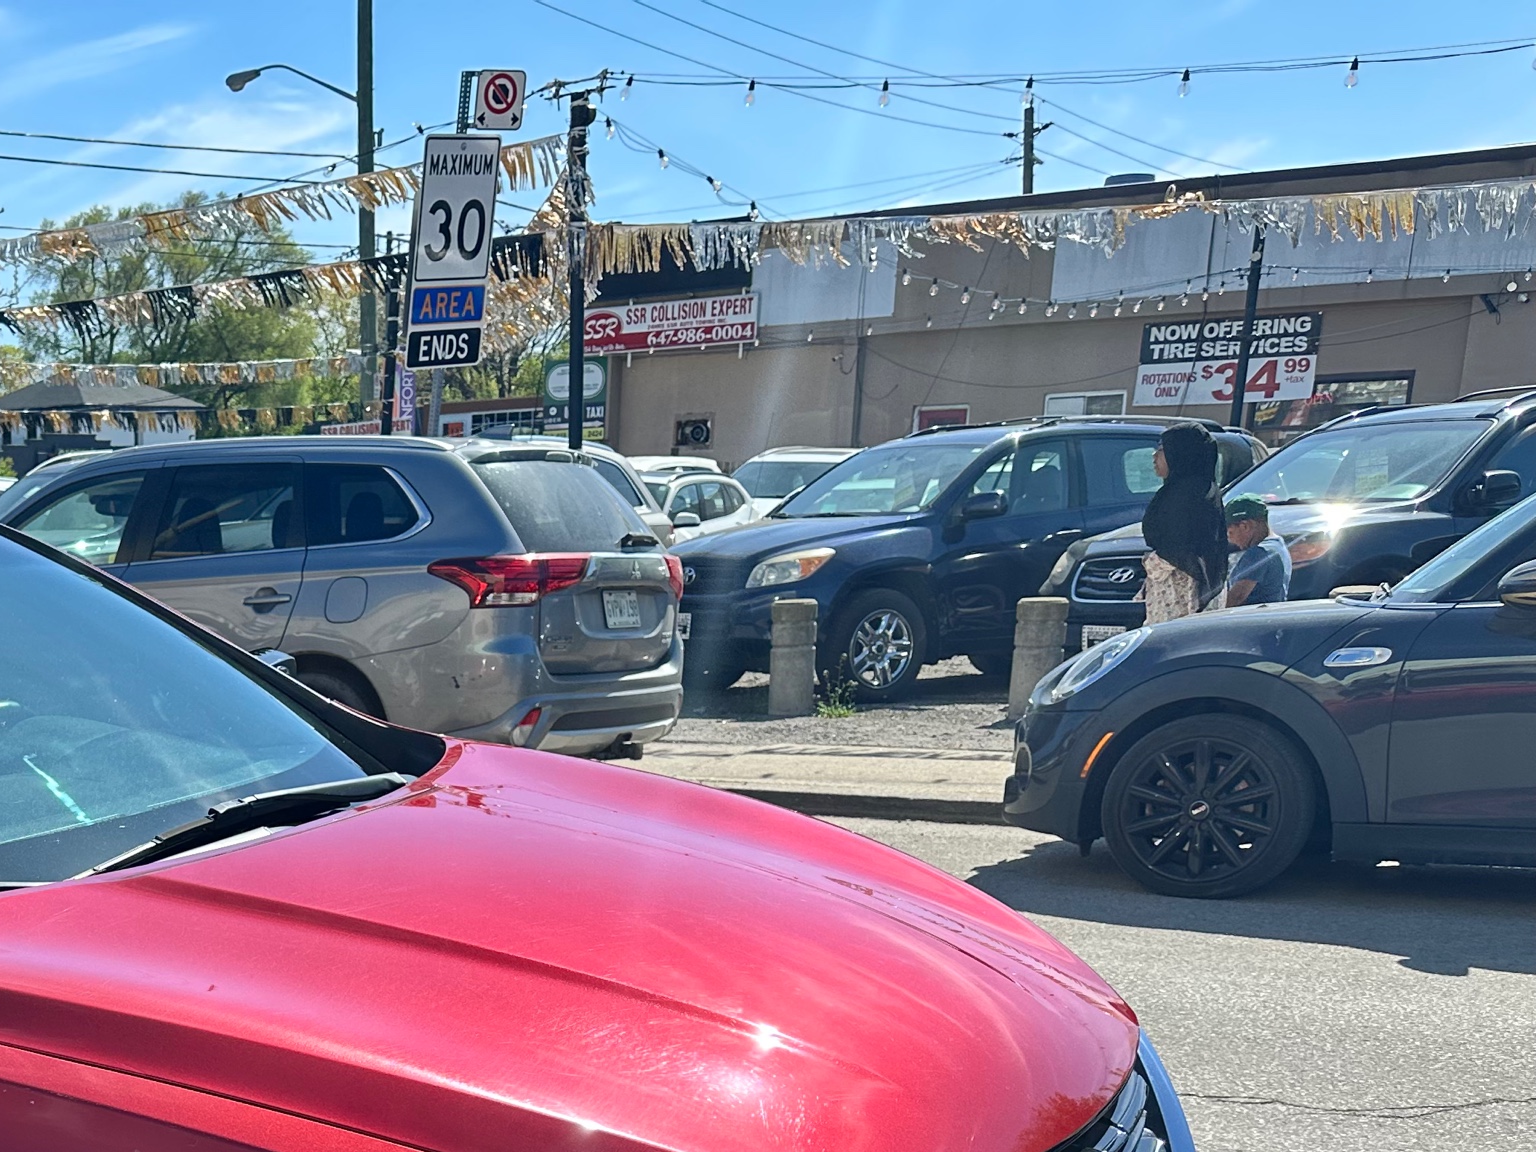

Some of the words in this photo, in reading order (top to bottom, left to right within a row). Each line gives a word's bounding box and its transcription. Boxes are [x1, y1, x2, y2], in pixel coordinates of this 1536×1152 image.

[429, 154, 494, 176] MAXIMUM
[424, 198, 486, 262] 30
[419, 291, 475, 319] AREA
[626, 307, 647, 325] SSR
[651, 301, 707, 323] COLLISION
[711, 298, 753, 317] EXPERT
[584, 317, 619, 339] SSR
[647, 325, 753, 346] 647-986-0004
[1149, 325, 1201, 342] NOW
[417, 332, 469, 362] ENDS
[1150, 343, 1197, 360] TIRE
[1141, 371, 1197, 385] ROTATIONS
[1284, 374, 1305, 384] +tax
[1154, 386, 1182, 398] ONLY
[586, 406, 604, 418] TAXI
[392, 420, 411, 432] PERT
